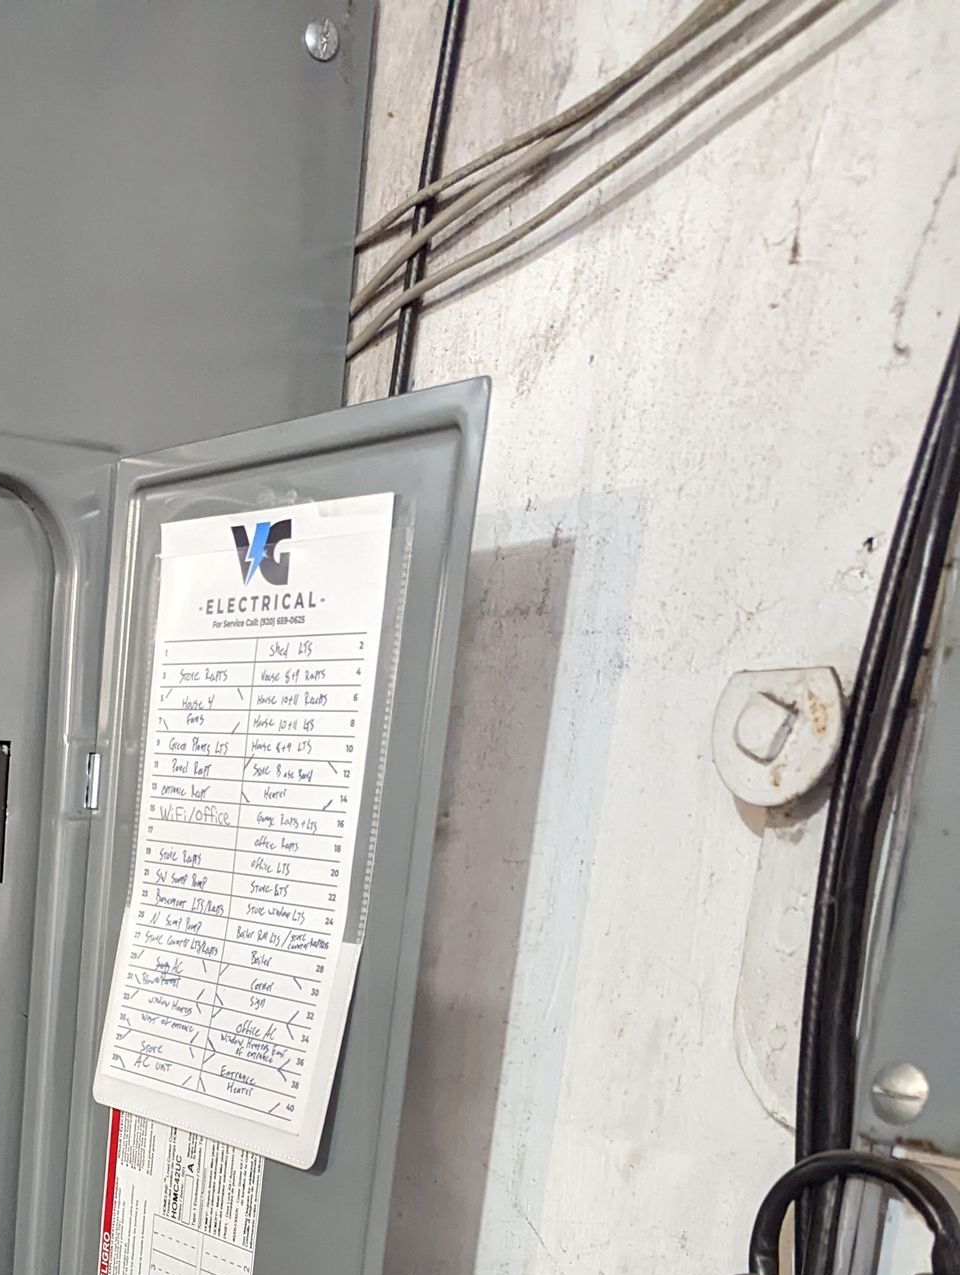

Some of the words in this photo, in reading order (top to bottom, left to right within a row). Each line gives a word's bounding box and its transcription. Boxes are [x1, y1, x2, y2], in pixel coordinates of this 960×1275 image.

[212, 619, 223, 629] For
[223, 618, 245, 628] Service
[259, 617, 275, 628] (920)
[277, 615, 305, 625] 659-0625
[359, 640, 364, 650] 2
[353, 693, 359, 702] 6
[350, 718, 356, 728] 8
[346, 744, 354, 753] 10
[343, 769, 351, 778] 12
[340, 795, 348, 803] 14
[337, 820, 345, 828] 16
[334, 844, 342, 853] 18
[330, 869, 339, 877] 20
[328, 893, 337, 901] 22
[138, 910, 145, 918] 25
[324, 917, 334, 926] 24
[316, 964, 324, 973] 28
[310, 988, 320, 997] 30
[305, 1012, 315, 1020] 32
[300, 1034, 310, 1043] 34
[296, 1057, 305, 1066] 36
[291, 1081, 300, 1089] 38
[286, 1104, 295, 1113] 40
[170, 1154, 183, 1220] HOMC42UC
[244, 1265, 250, 1273] 2
